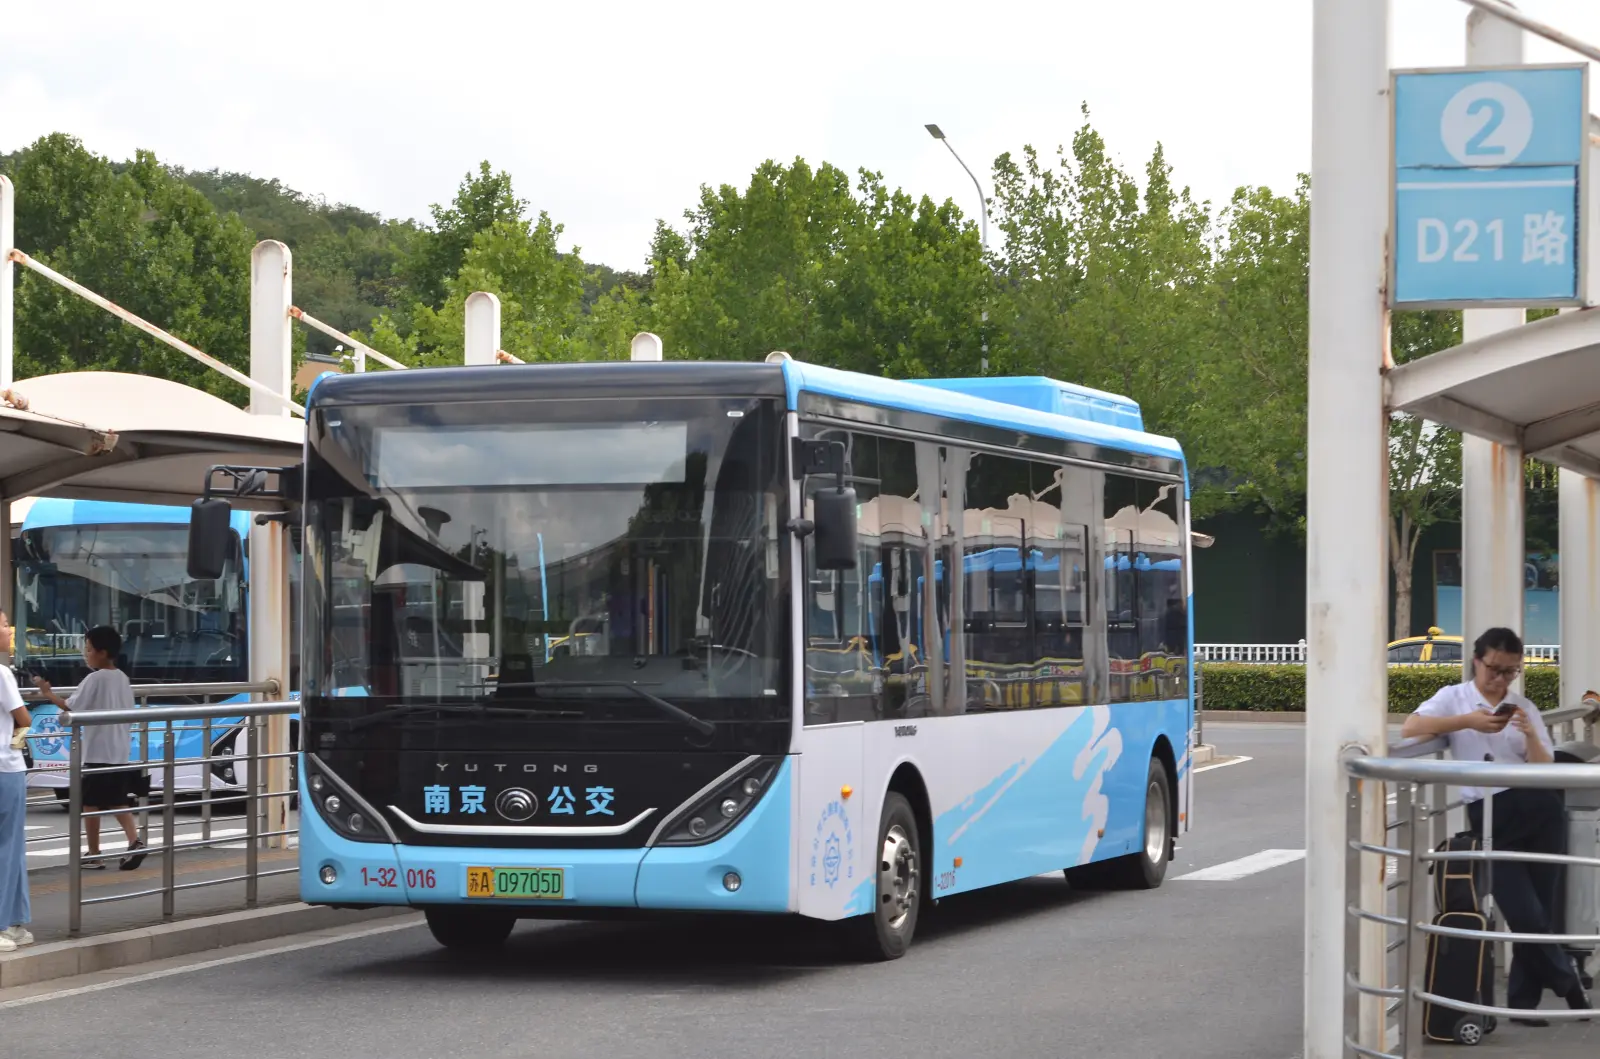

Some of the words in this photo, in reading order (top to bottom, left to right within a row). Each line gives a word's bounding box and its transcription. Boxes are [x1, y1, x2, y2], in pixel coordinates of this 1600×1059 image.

[1464, 97, 1506, 157] 2
[1416, 217, 1505, 263] D21
[1522, 210, 1568, 266] 路
[436, 763, 599, 773] YUTONG
[423, 784, 487, 814] 南京
[547, 785, 615, 816] 公交
[360, 866, 398, 888] 1-32
[406, 868, 437, 889] 016
